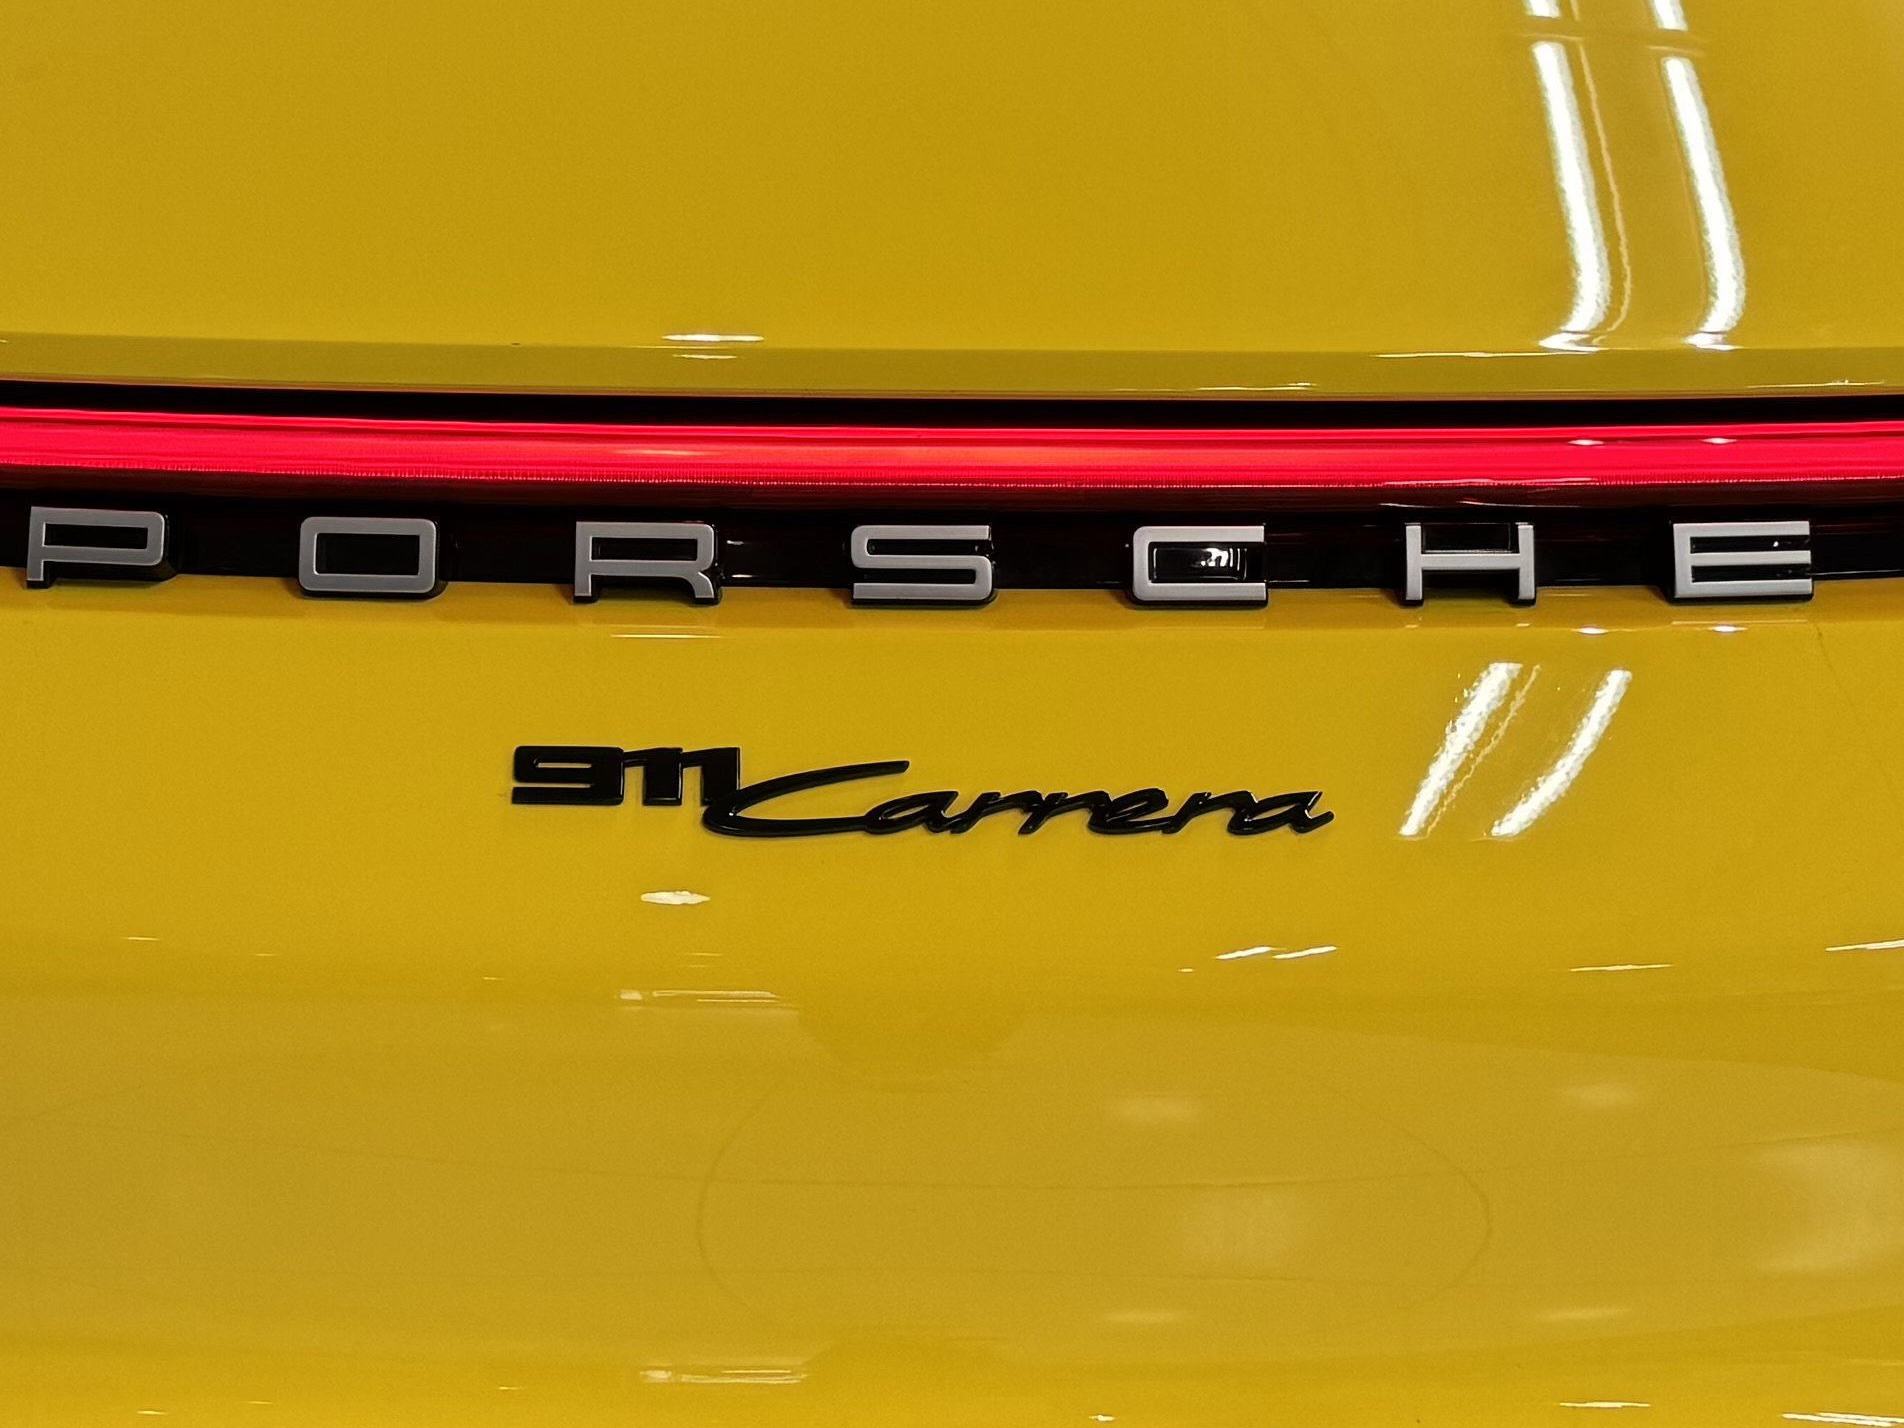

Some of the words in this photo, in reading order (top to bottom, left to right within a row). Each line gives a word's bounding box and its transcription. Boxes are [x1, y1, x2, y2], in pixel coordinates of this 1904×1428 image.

[25, 506, 1814, 603] PORSCHE
[511, 745, 742, 807] 911
[702, 760, 1336, 839] Carrera
